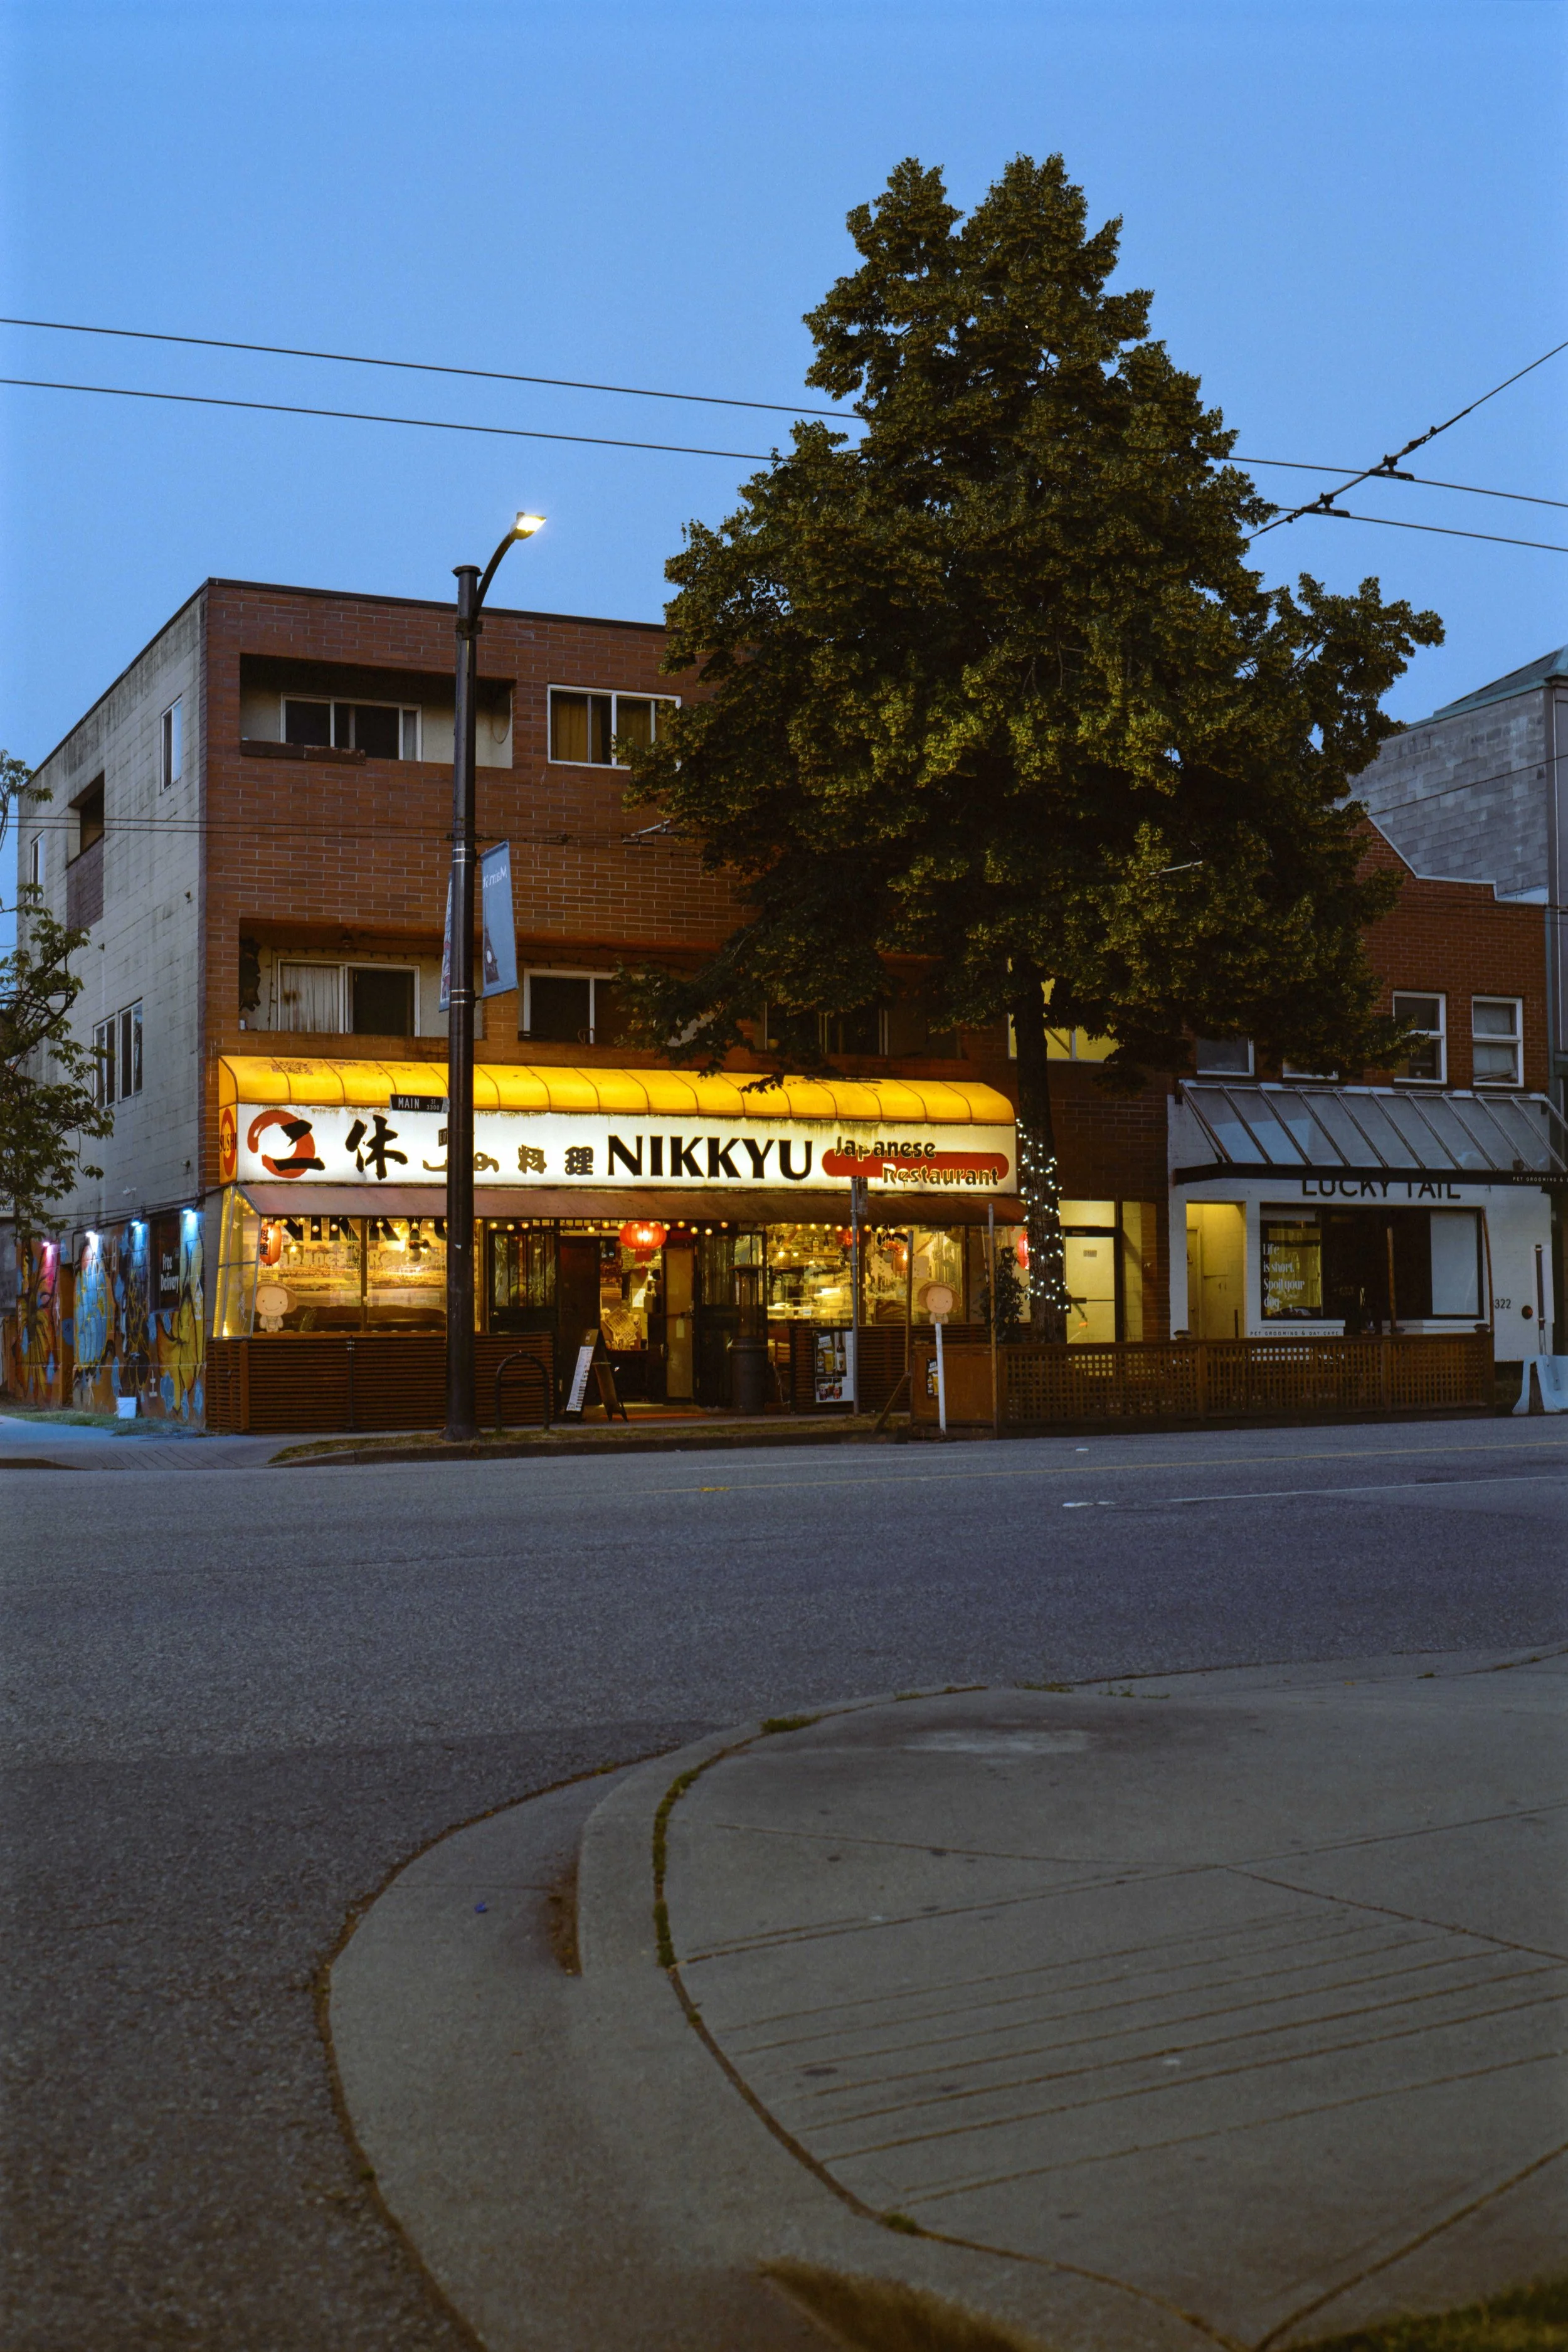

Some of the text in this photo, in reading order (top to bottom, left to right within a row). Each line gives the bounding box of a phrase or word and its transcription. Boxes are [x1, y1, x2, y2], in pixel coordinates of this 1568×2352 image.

[398, 1097, 420, 1109] MAIN
[220, 1133, 237, 1152] SUSHI
[834, 1136, 936, 1161] Japanese
[608, 1135, 813, 1180] NIKKYU
[882, 1165, 999, 1185] Restaurant
[1263, 1243, 1279, 1255] Life
[163, 1253, 172, 1271] Free
[1263, 1261, 1269, 1273] is
[161, 1272, 179, 1294] Delivery
[1263, 1278, 1305, 1292] Spoil your
[1264, 1296, 1279, 1310] dog
[1493, 1298, 1511, 1309] 322
